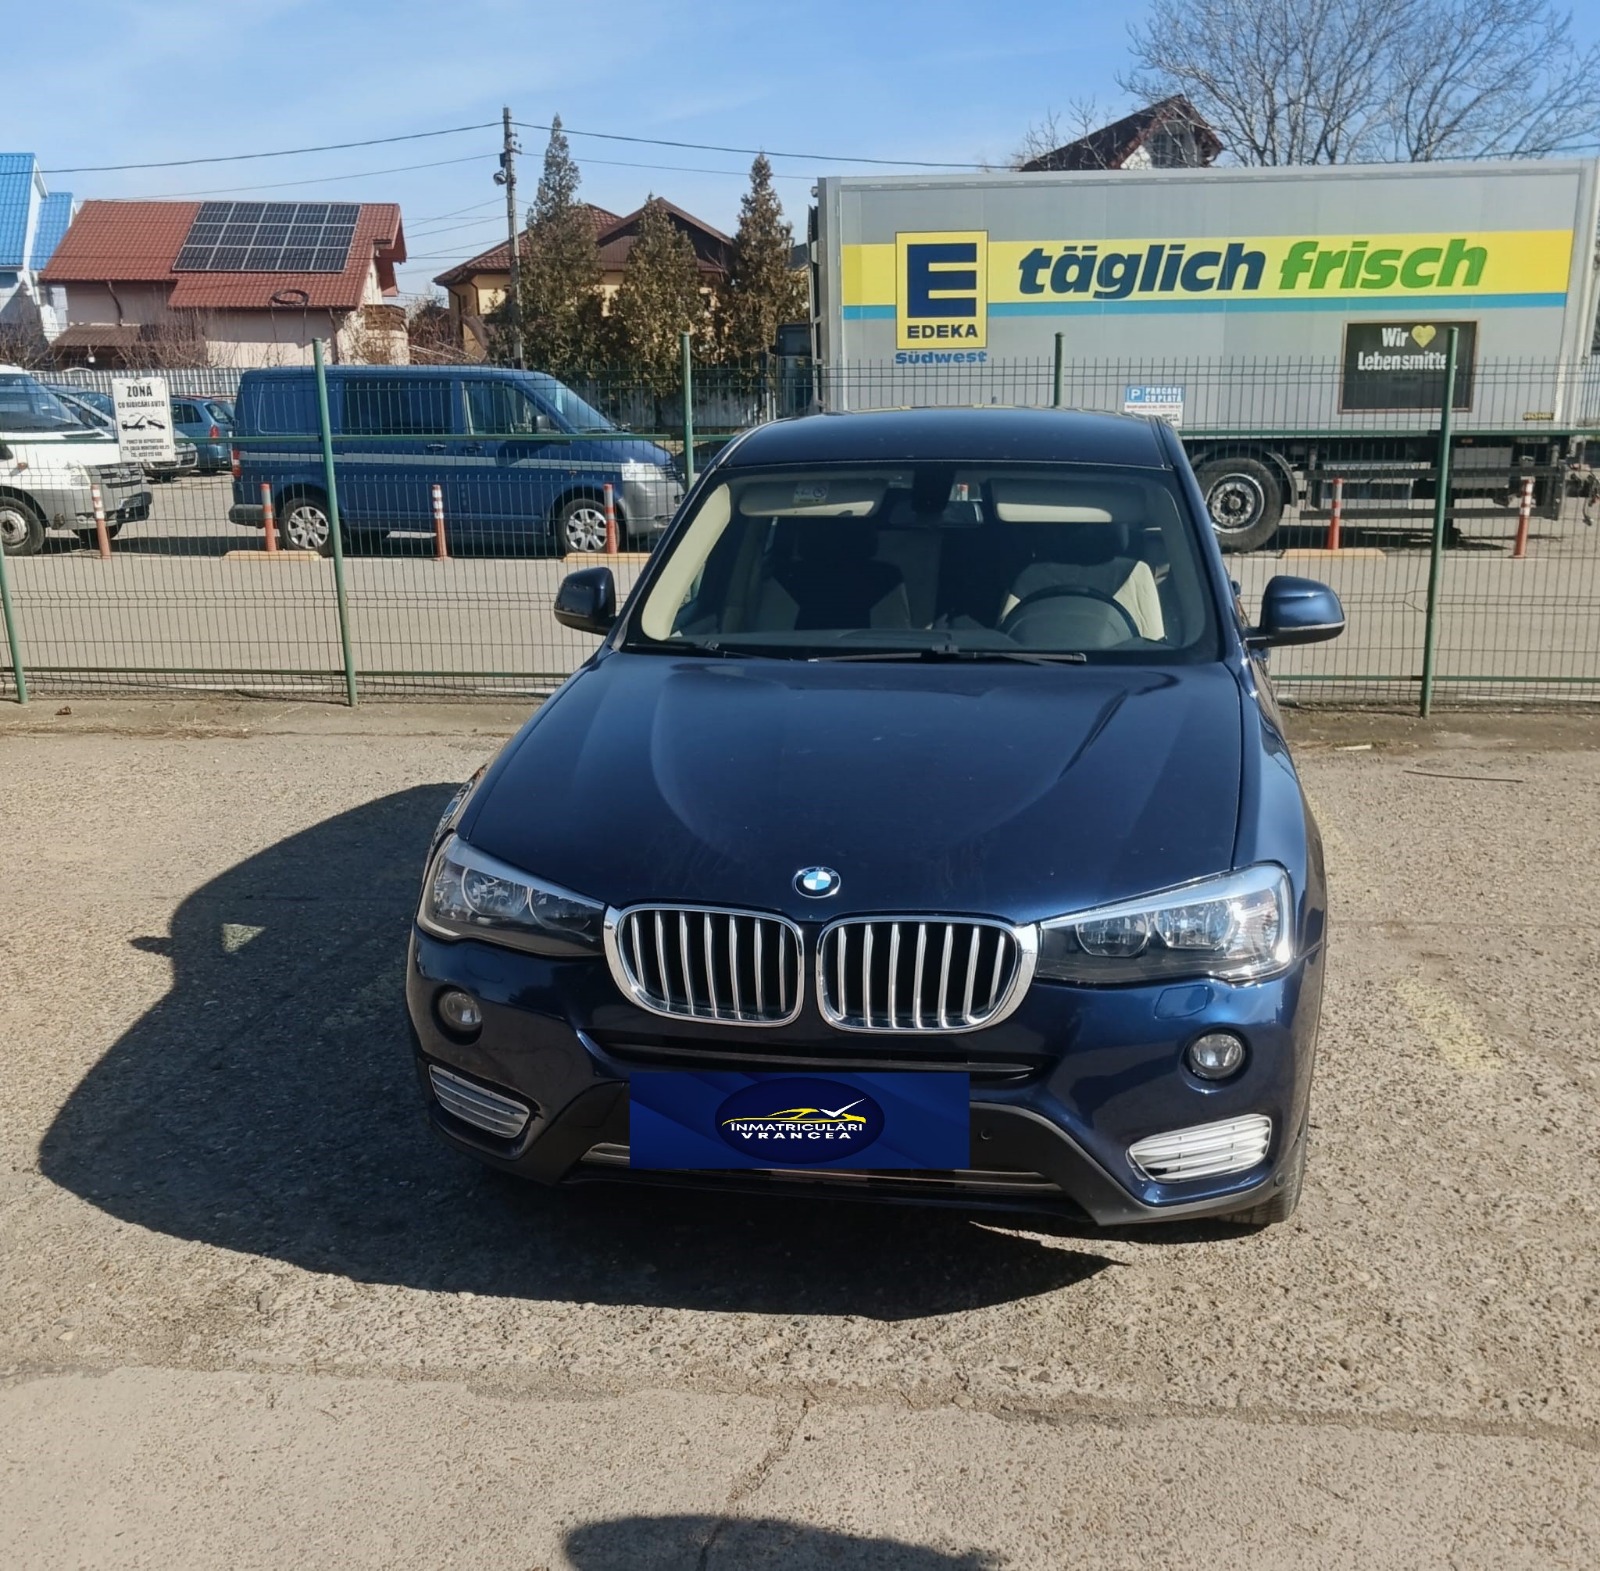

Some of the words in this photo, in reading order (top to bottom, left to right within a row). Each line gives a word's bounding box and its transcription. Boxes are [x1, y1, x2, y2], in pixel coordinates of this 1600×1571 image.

[1018, 243, 1266, 300] täglich
[1279, 238, 1489, 289] frisch
[906, 242, 977, 318] E
[907, 324, 978, 339] EDEKA
[1381, 327, 1409, 347] Wir
[895, 351, 987, 364] Südwest
[1145, 387, 1182, 395] PARCARE
